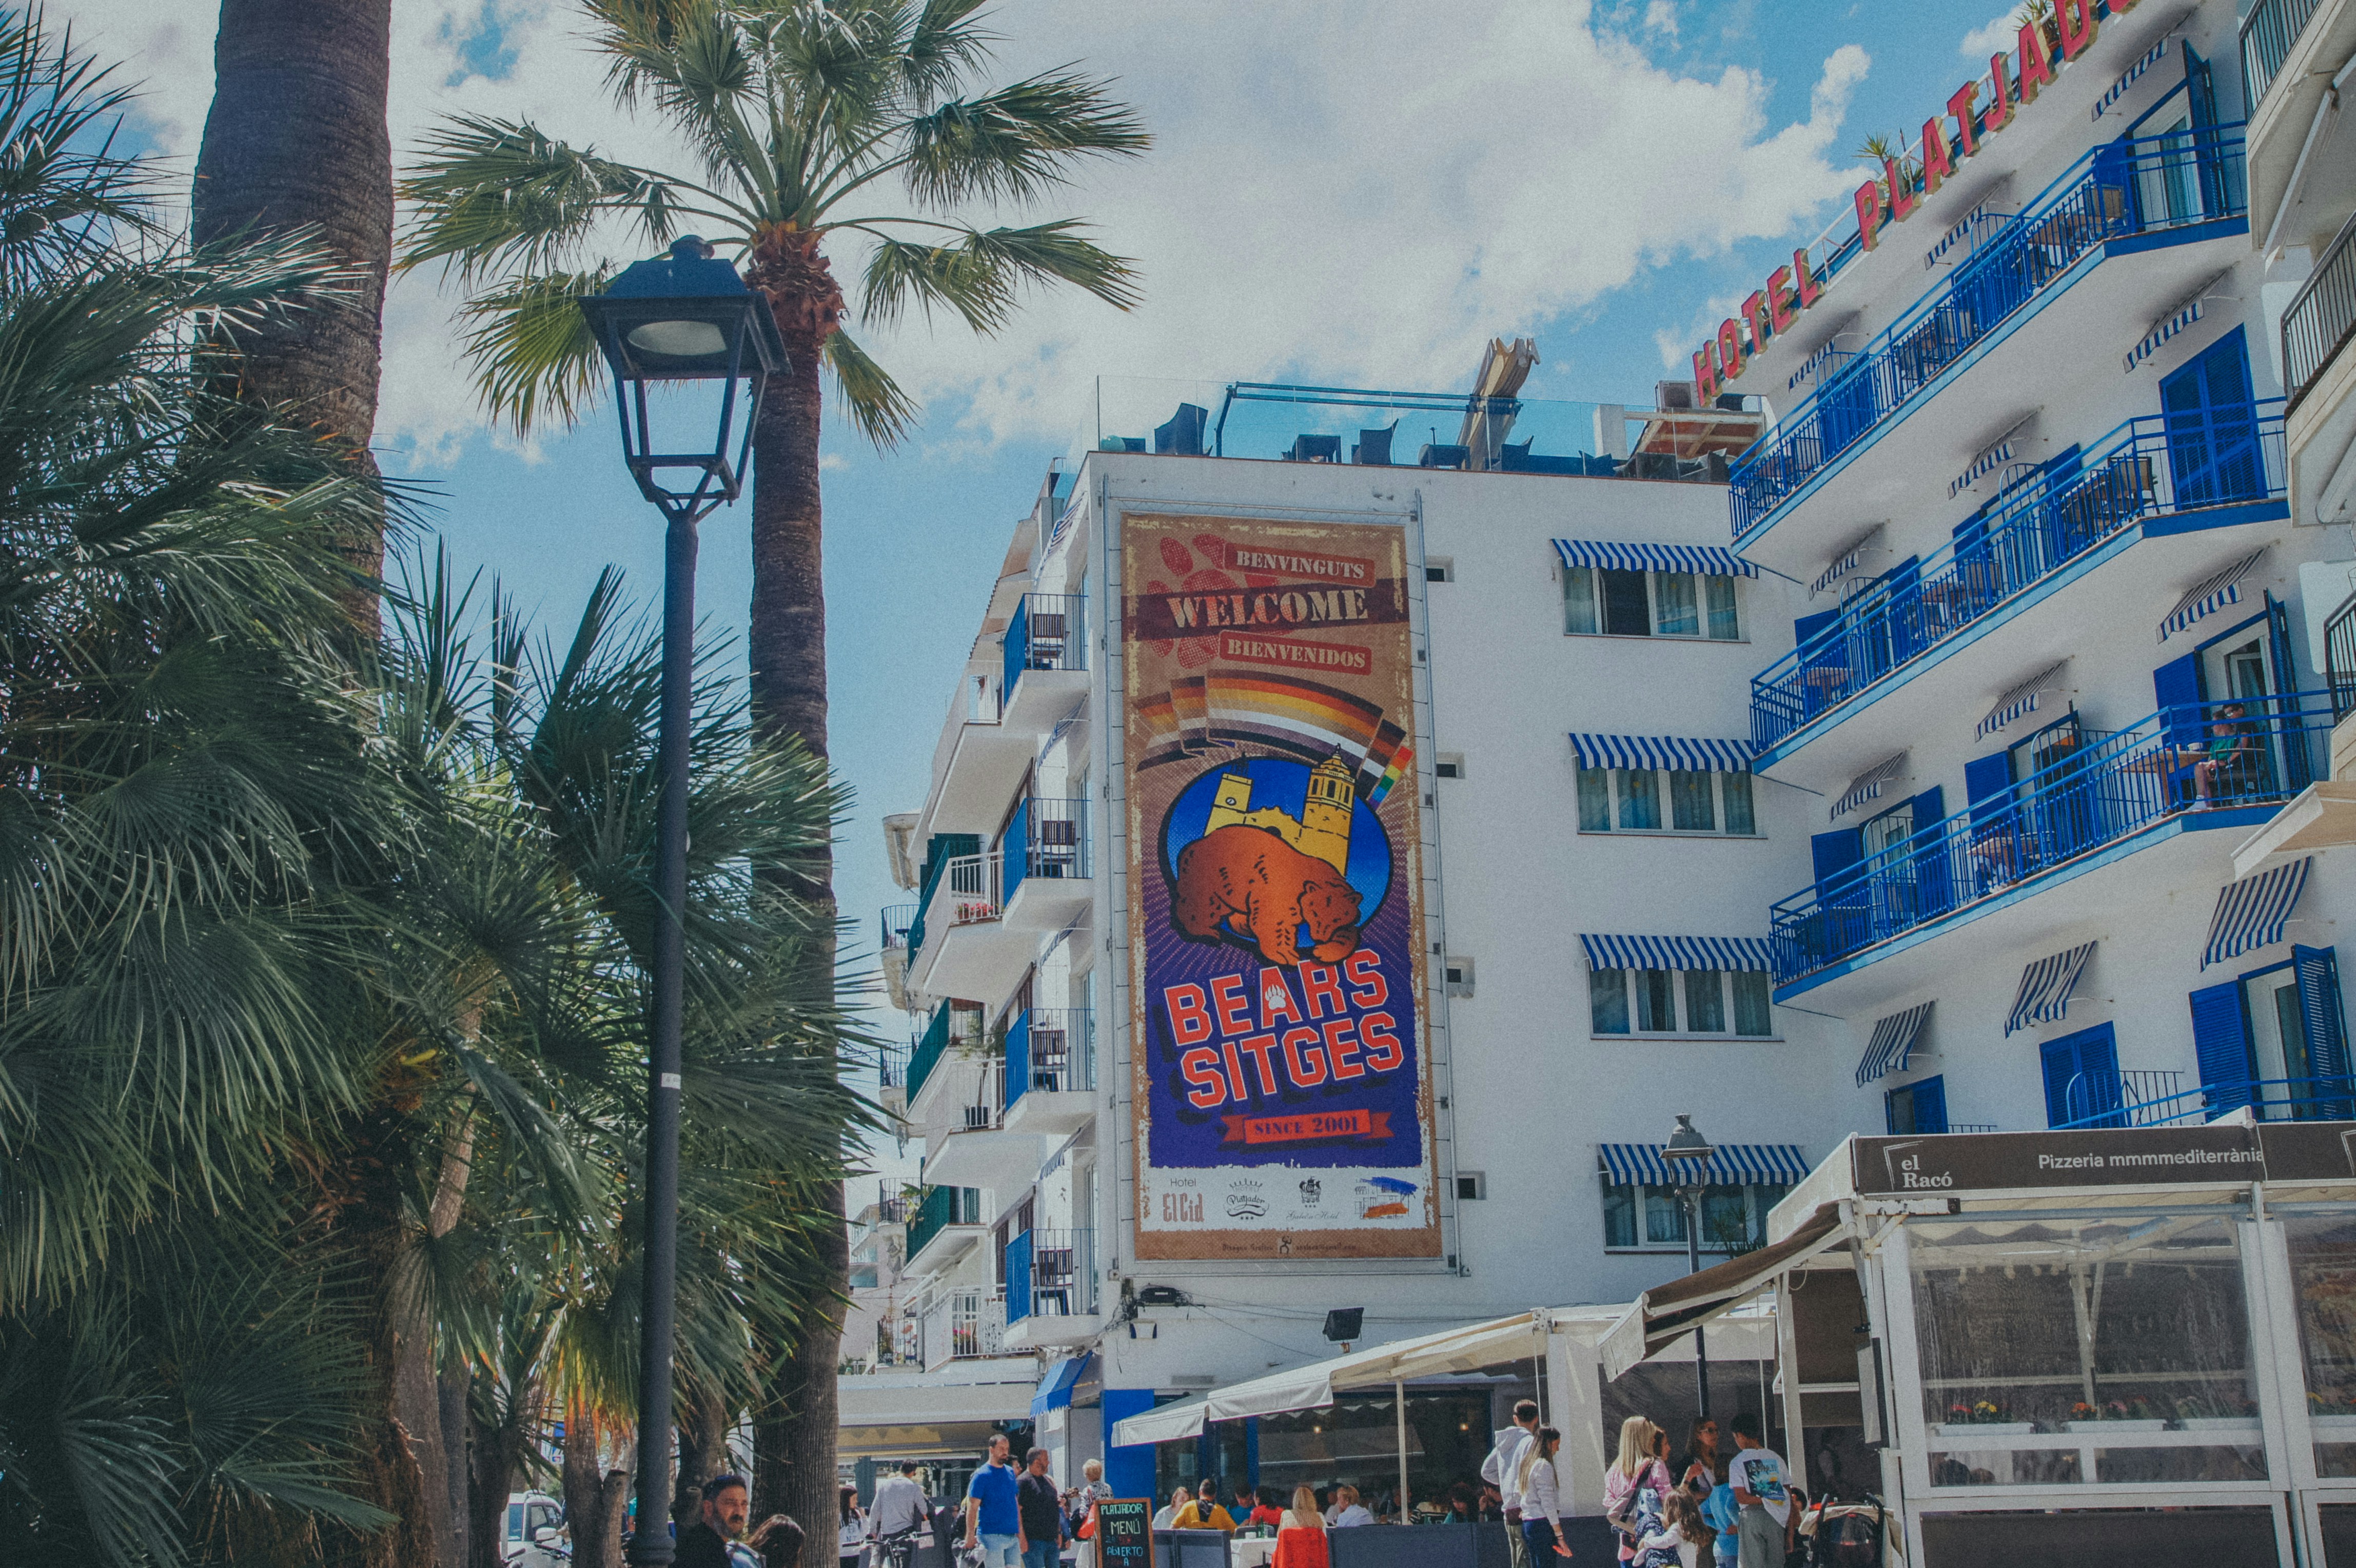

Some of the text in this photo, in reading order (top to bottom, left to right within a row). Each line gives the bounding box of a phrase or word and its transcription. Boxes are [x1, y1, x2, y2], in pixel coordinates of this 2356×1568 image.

[1693, 0, 2132, 406] HOTEL PLATJAD
[1236, 550, 1365, 579] BENVINGUTS
[1166, 589, 1369, 629] WELCOME
[1227, 639, 1365, 668] BIENVENIDOS
[1164, 949, 1388, 1046] BEARS
[1181, 1011, 1404, 1108] SITGES
[1254, 1115, 1359, 1136] SINCE 2001
[1901, 1155, 1920, 1170] el
[2038, 1153, 2104, 1169] Pizzeria
[1170, 1178, 1196, 1187] Hotel
[1902, 1171, 1953, 1188] Racó
[1163, 1192, 1205, 1223] El Cid
[1101, 1503, 1143, 1515] PLATJADOR
[1110, 1518, 1141, 1535] MENÚ
[1124, 1557, 1129, 1566] A
